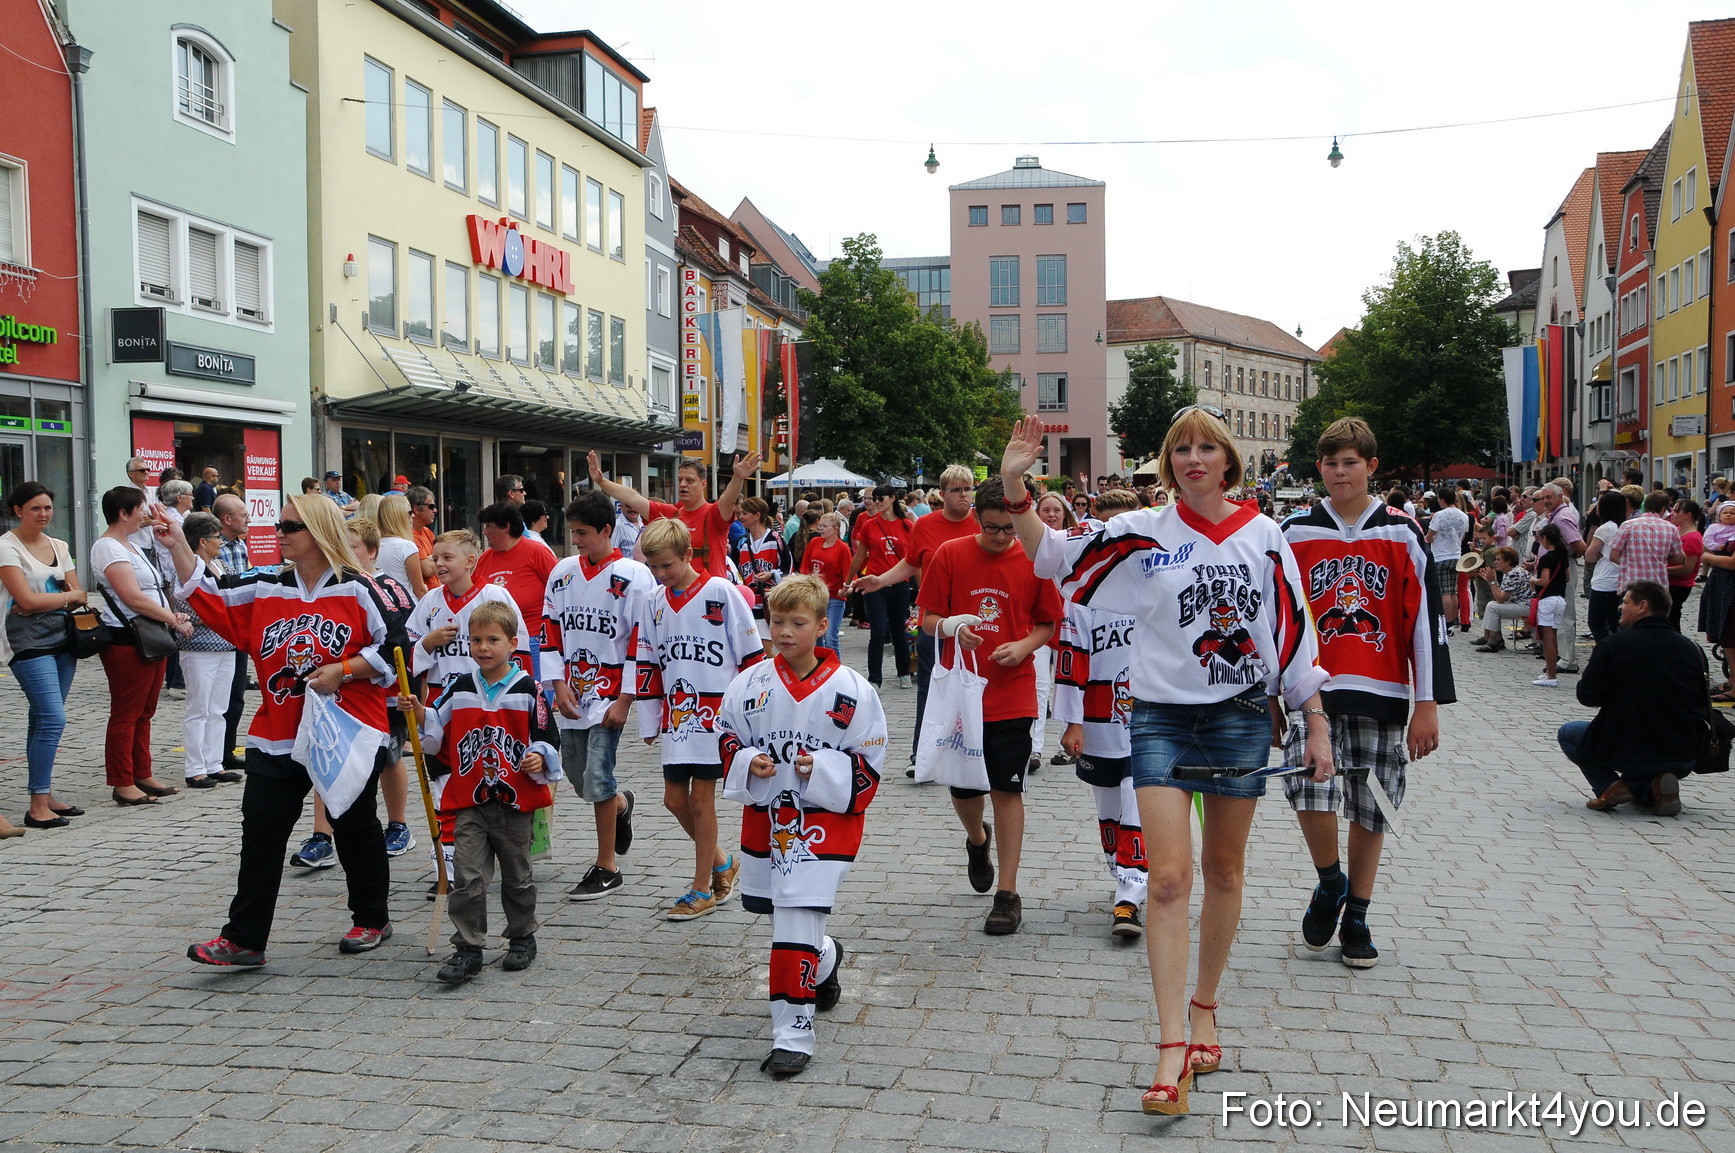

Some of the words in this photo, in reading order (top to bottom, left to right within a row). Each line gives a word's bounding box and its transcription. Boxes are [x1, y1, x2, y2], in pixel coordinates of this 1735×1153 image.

[466, 214, 575, 295] WÖHRL
[685, 270, 696, 390] BÄCKEREI
[1044, 424, 1069, 432] asse
[136, 447, 175, 459] RÄUMUNGS-
[247, 455, 277, 466] RÄUMUNGS-
[247, 465, 276, 477] VERKAUF
[250, 499, 275, 518] 70%
[1191, 563, 1252, 587] Young
[1309, 555, 1389, 602] Eagles
[1177, 578, 1262, 628] Eagles
[260, 613, 352, 660] Eagles
[1207, 654, 1256, 686] Neumarkt
[457, 725, 527, 776] Eagles
